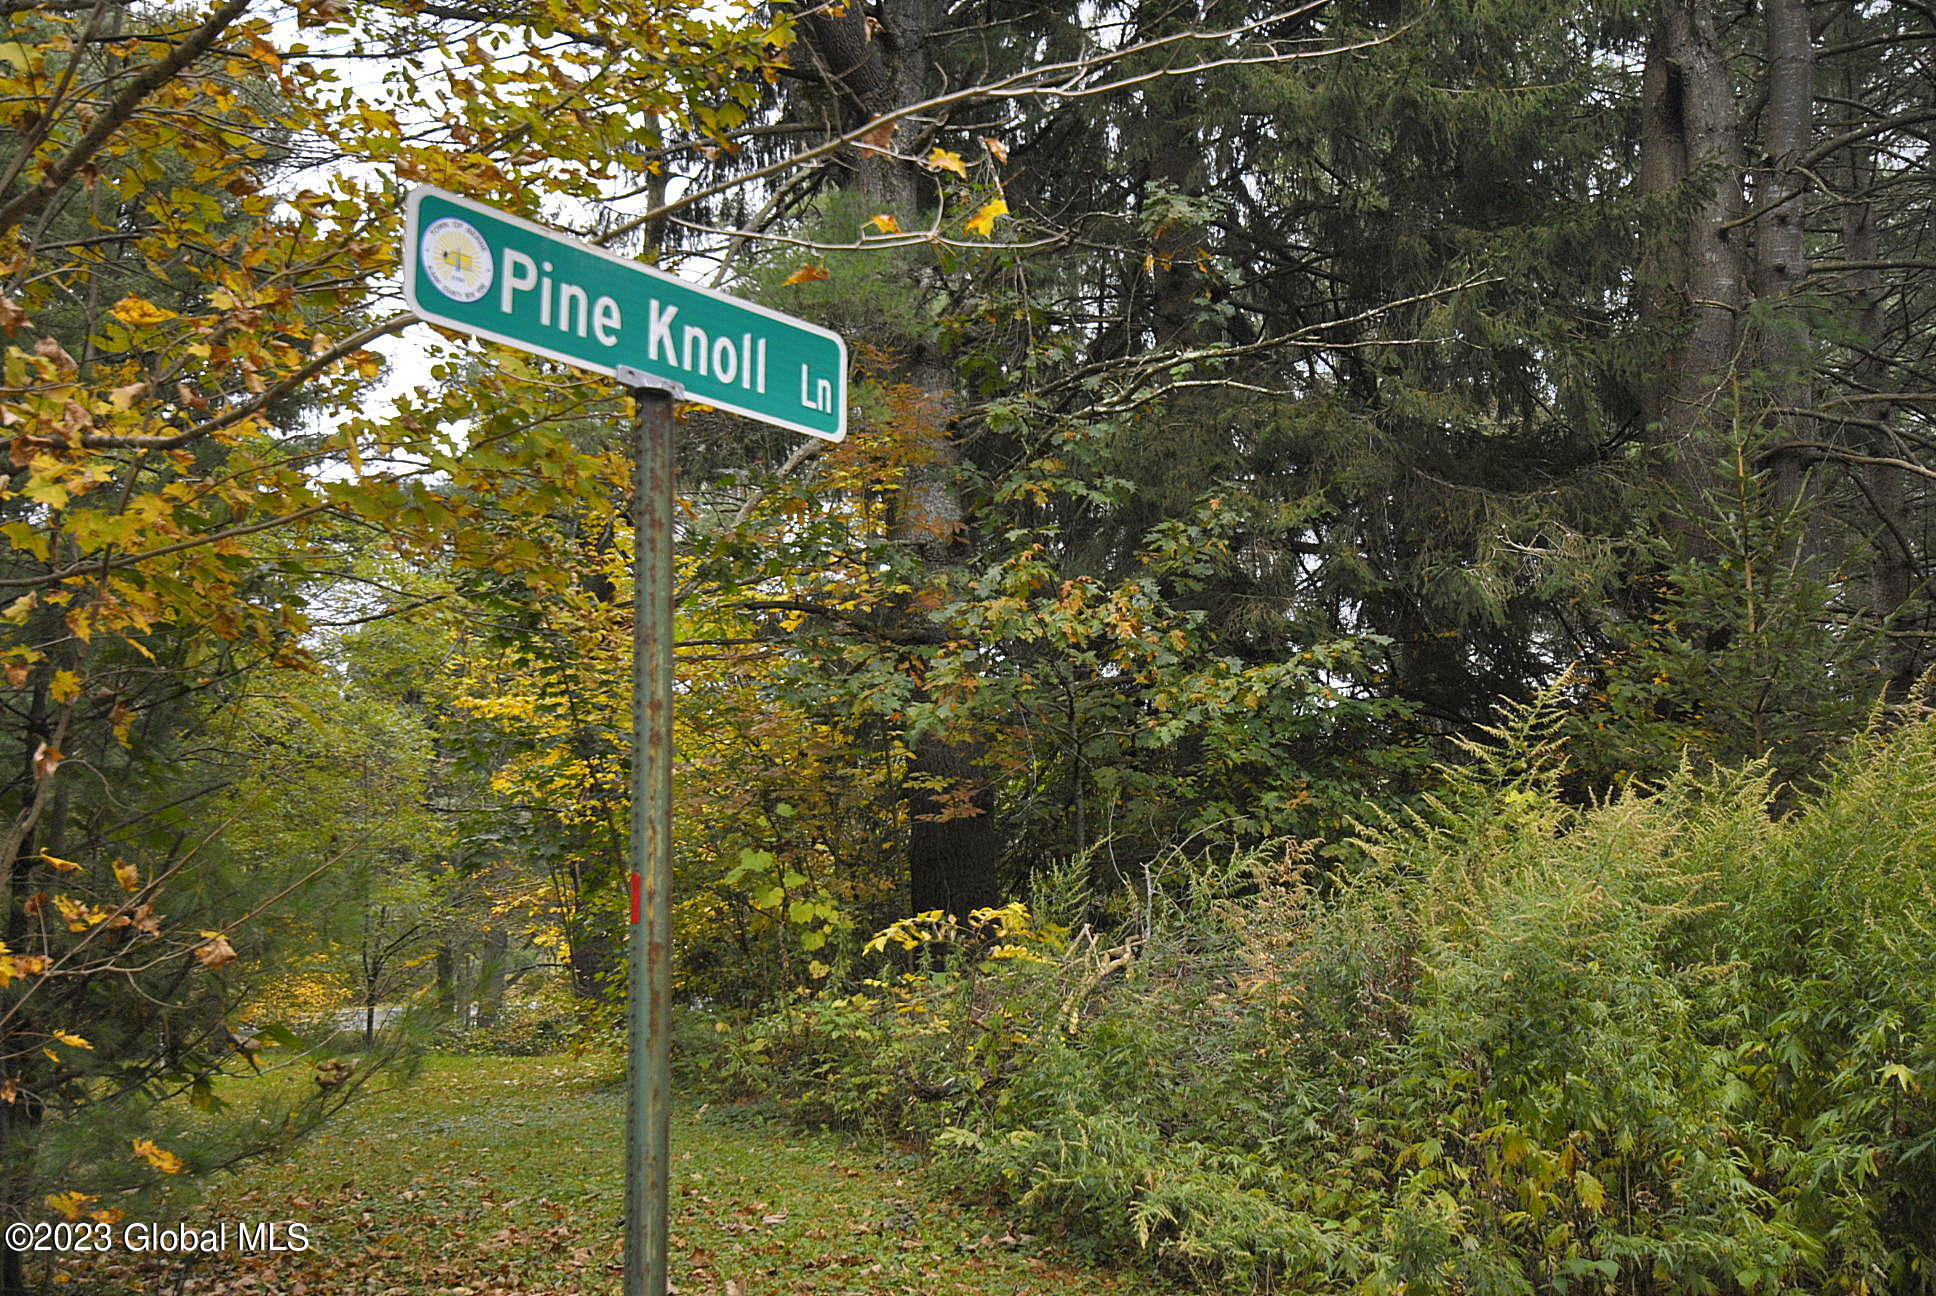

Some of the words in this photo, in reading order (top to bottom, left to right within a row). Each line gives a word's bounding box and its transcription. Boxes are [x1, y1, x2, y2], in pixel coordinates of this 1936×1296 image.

[500, 247, 622, 347] Pine
[648, 299, 768, 395] Knoll
[800, 363, 833, 414] Ln
